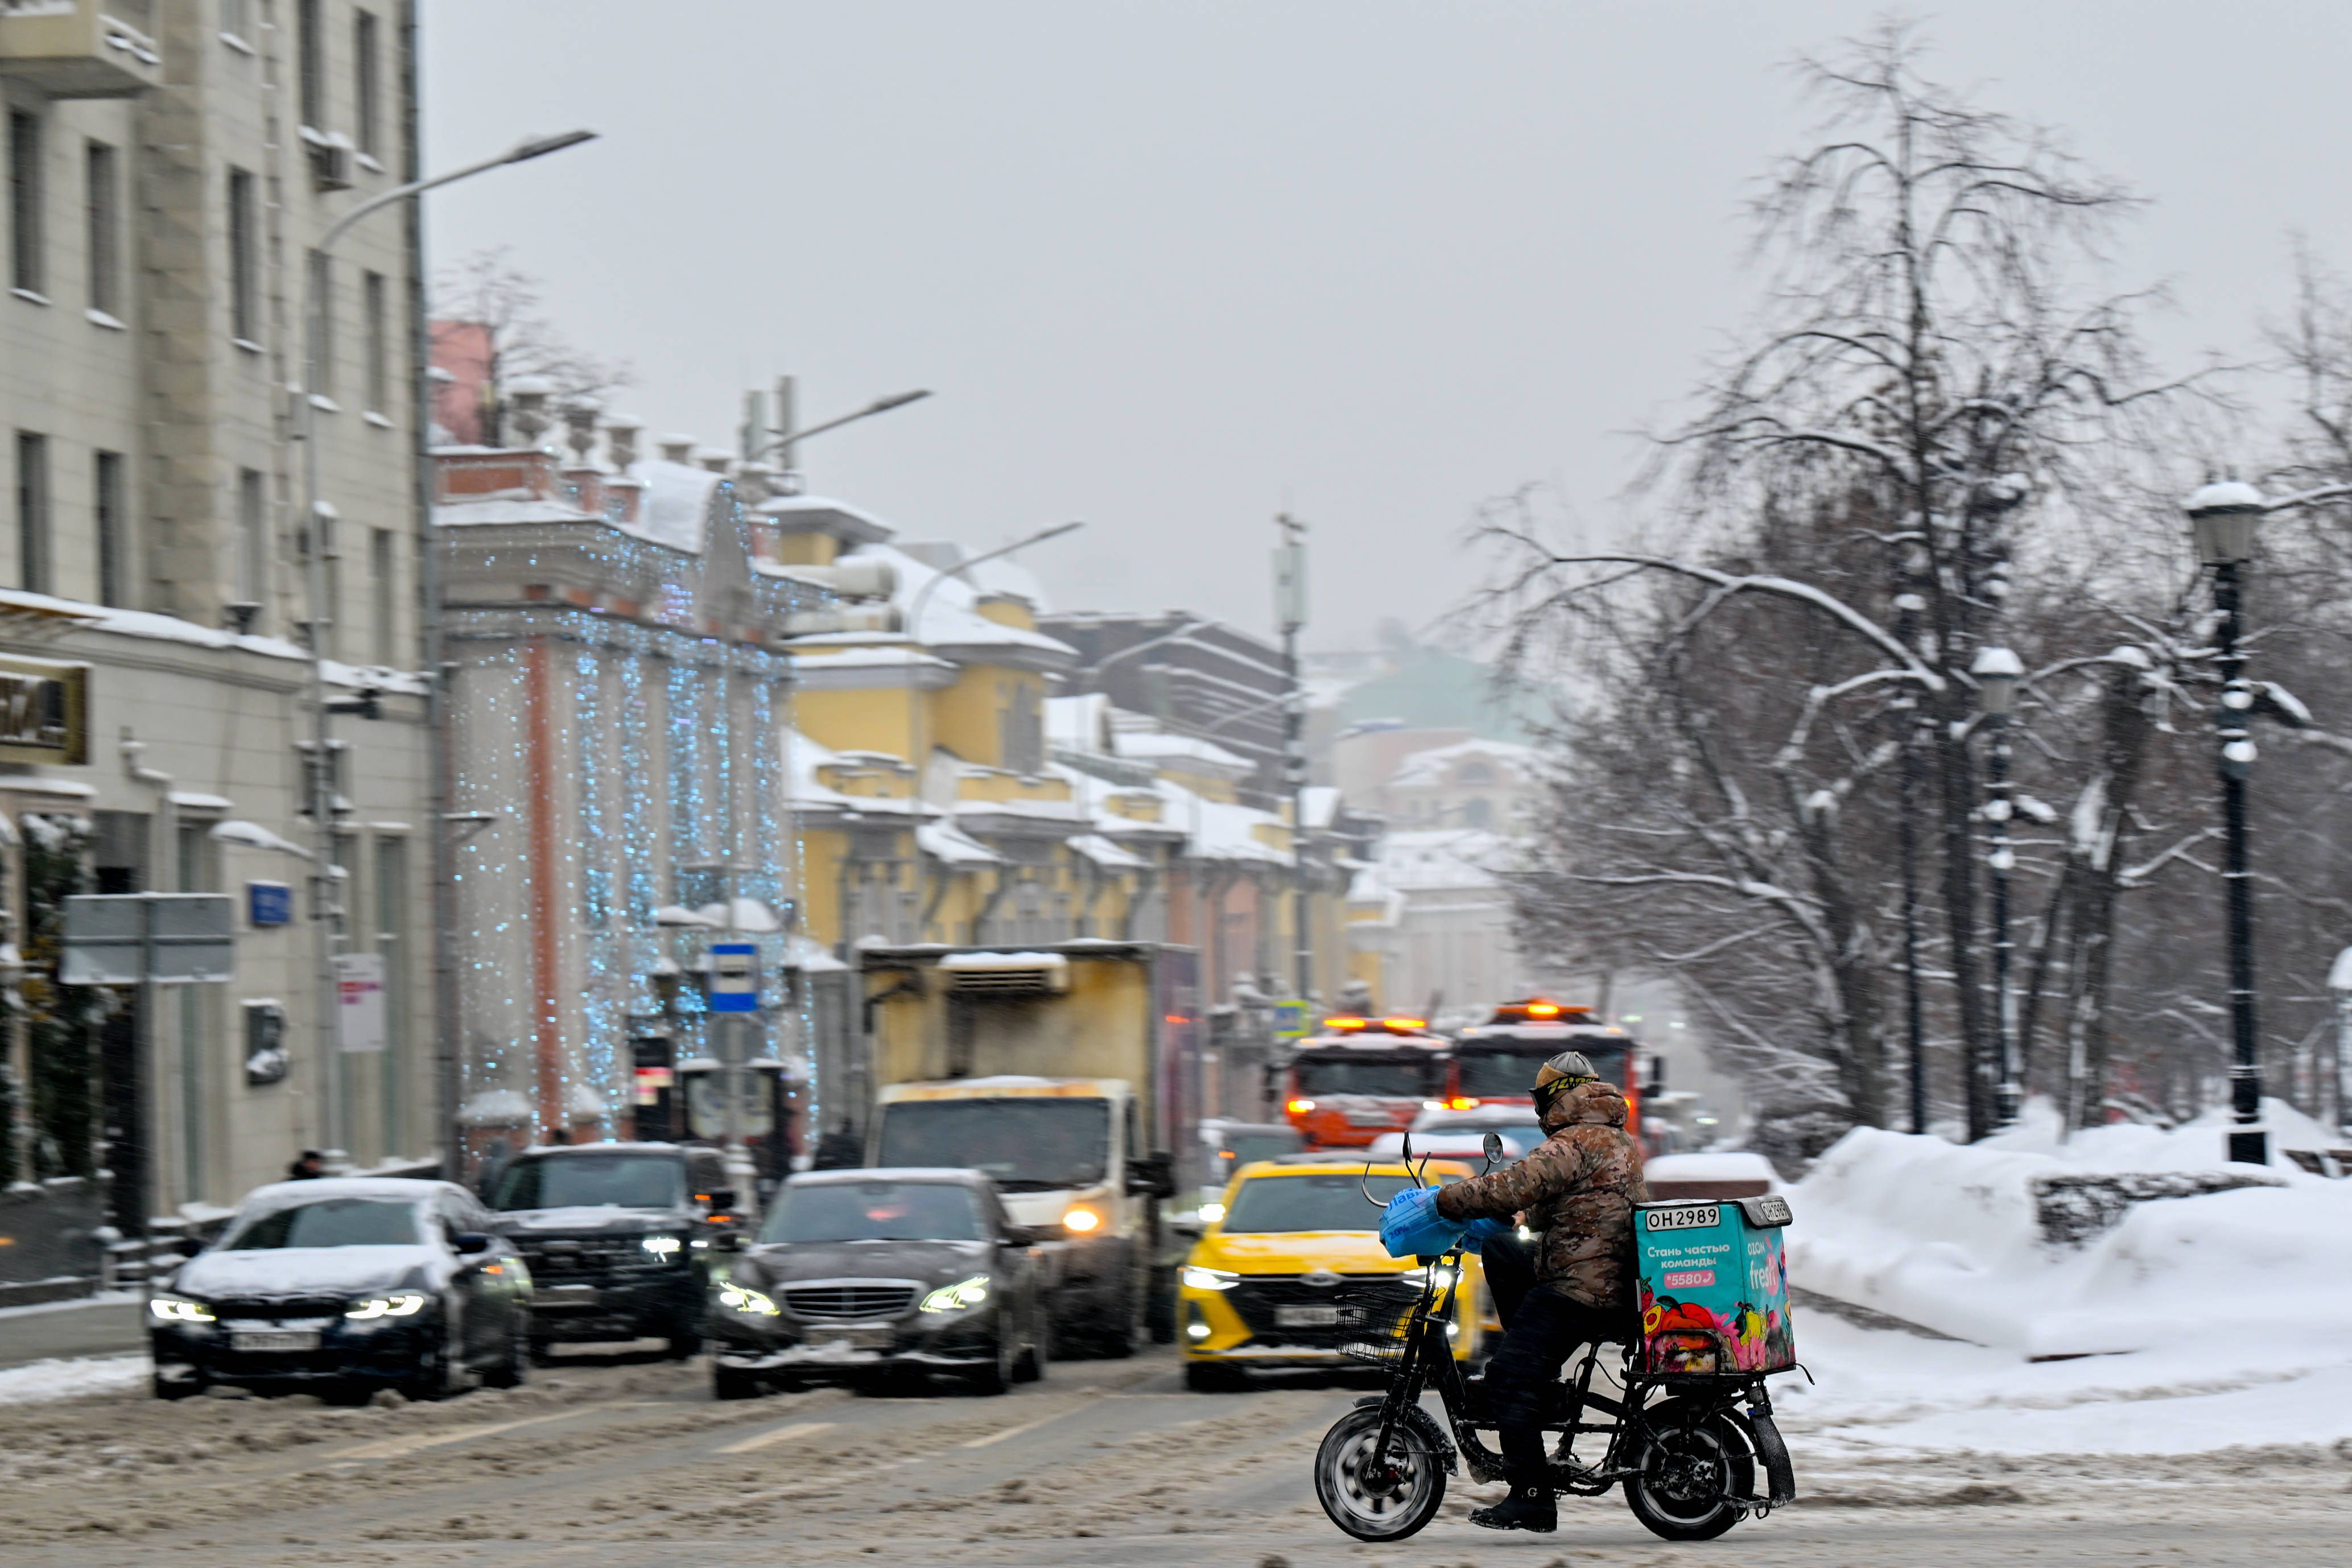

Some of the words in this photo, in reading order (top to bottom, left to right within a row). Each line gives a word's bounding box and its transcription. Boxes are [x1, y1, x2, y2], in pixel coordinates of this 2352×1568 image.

[1388, 1224, 1409, 1240] 20%
[1648, 1246, 1682, 1257] Стань
[1685, 1244, 1730, 1255] частью
[1747, 1241, 1765, 1256] OZON
[1661, 1257, 1716, 1269] команды
[1749, 1257, 1776, 1290] fresh
[1527, 1487, 1538, 1497] G
